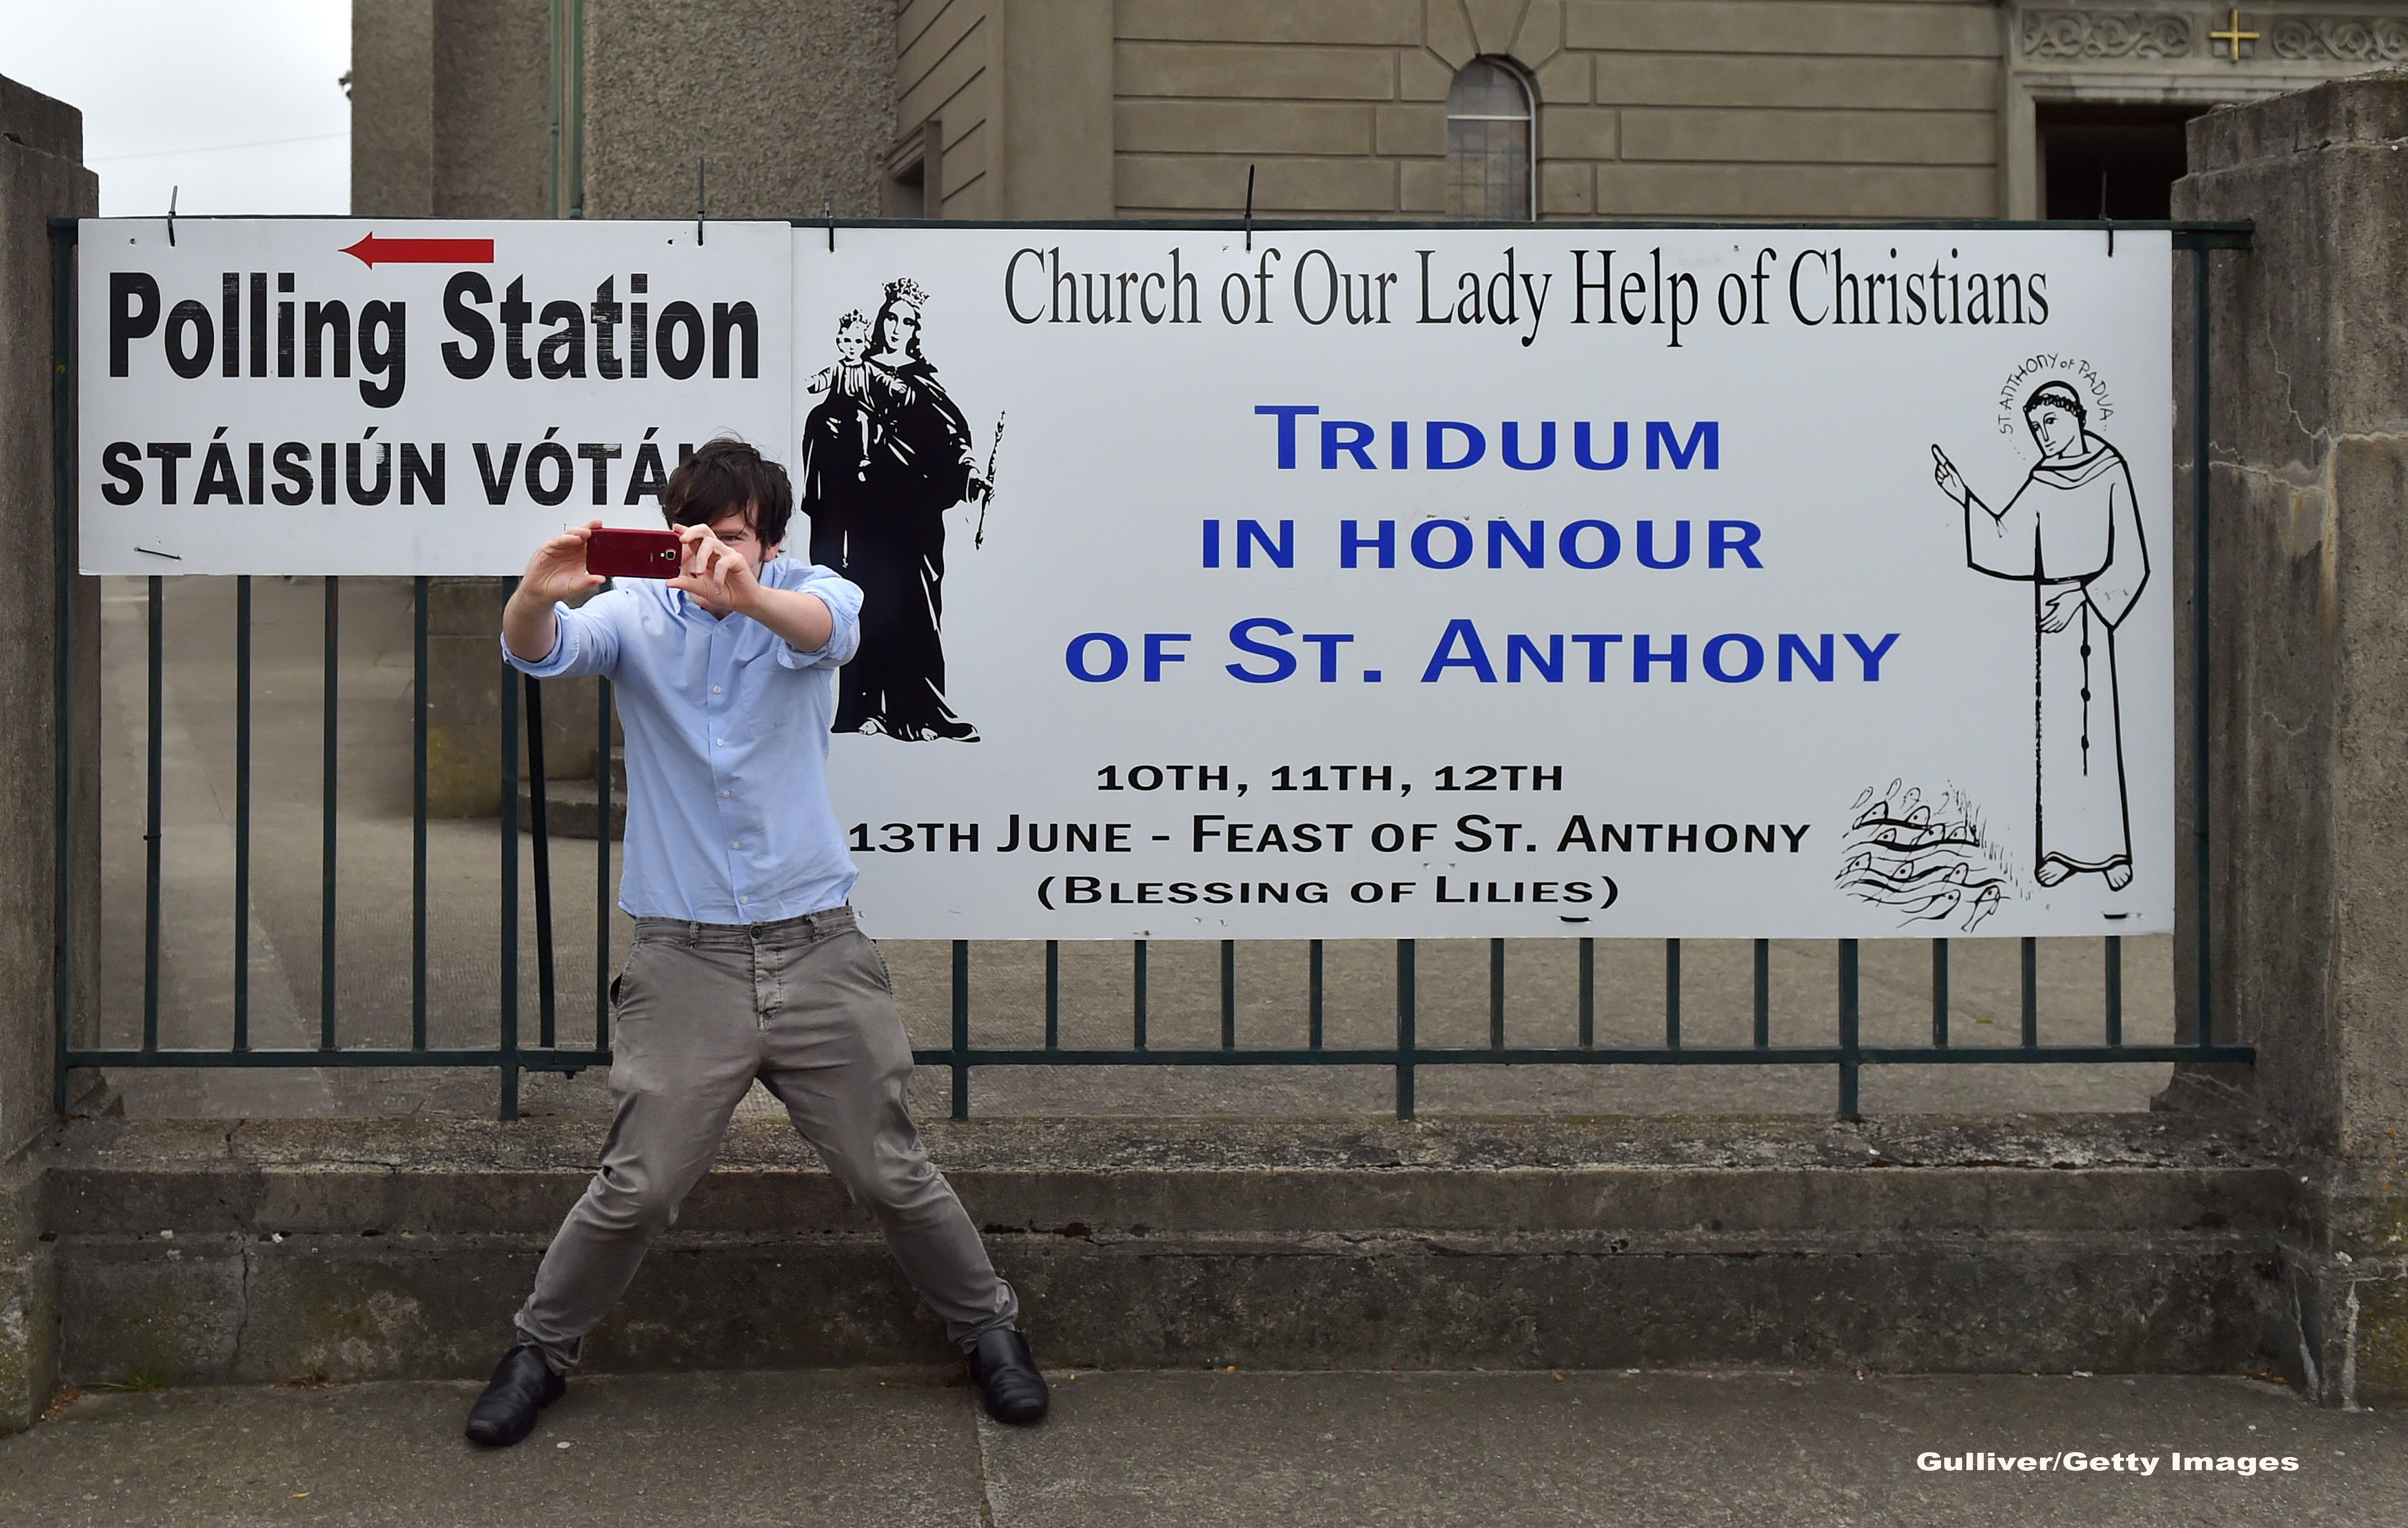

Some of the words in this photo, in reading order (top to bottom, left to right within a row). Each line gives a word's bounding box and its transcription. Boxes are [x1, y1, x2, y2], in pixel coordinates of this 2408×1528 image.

[1005, 247, 1202, 325] Church
[1221, 248, 1281, 325] of
[1294, 249, 1397, 325] Our
[1414, 247, 1552, 347] Lady
[1570, 247, 1698, 347] Help
[1718, 247, 1777, 326] of
[1789, 247, 2049, 326] Christians
[109, 272, 406, 409] Polling
[440, 271, 759, 380] Station
[2078, 360, 2115, 421] PADUA
[101, 426, 445, 506] STÁISIÚN
[1254, 405, 1719, 471] TRIDUUM
[1202, 519, 1294, 569] IN
[1340, 519, 1764, 570] HONOUR
[1065, 633, 1192, 683] OF
[1225, 617, 1382, 683] ST.
[1420, 619, 1900, 683] ANTHONY
[1097, 765, 1247, 798] 10TH,
[1272, 765, 1411, 798] 11TH,
[1435, 765, 1563, 791] 12TH
[850, 823, 979, 853] 13TH
[997, 814, 1131, 852] JUNE
[1193, 815, 1353, 853] FEAST
[1371, 823, 1437, 852] OF
[1455, 814, 1536, 853] ST.
[1556, 815, 1811, 853] ANTHONY
[1038, 876, 1328, 910] (BLESSING
[1350, 882, 1416, 904] OF
